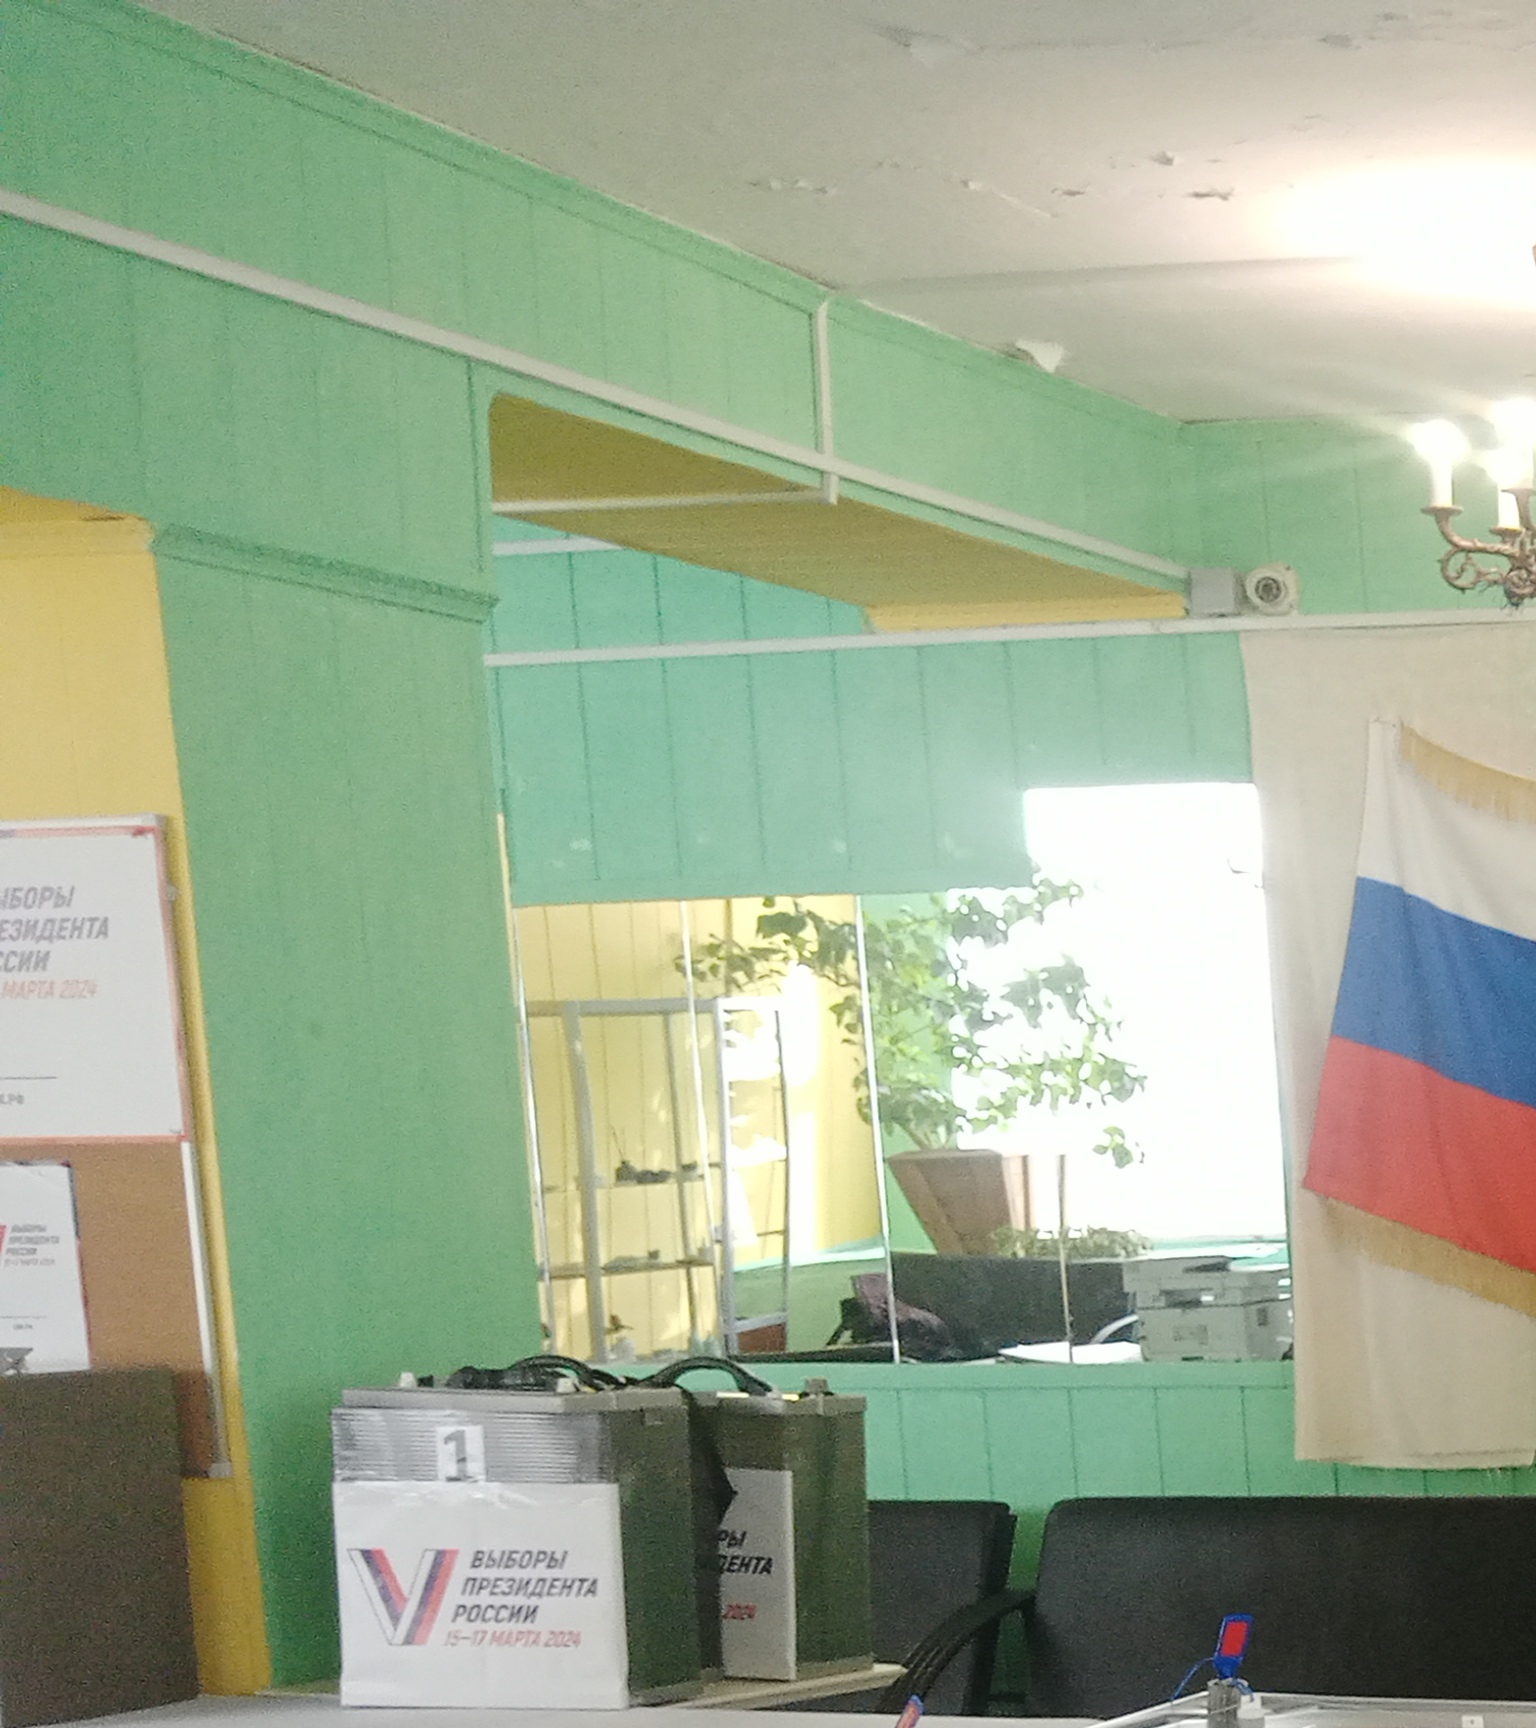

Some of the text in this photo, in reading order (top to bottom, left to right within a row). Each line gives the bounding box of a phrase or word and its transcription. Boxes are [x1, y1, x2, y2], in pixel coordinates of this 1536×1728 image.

[444, 1429, 478, 1483] 1
[469, 1549, 568, 1570] ВЫБОРЫ
[460, 1576, 599, 1600] ПРЕЗИДЕНТА
[450, 1603, 540, 1624] РОССИИ
[489, 1629, 542, 1648] МАРТА
[543, 1630, 582, 1648] 2024
